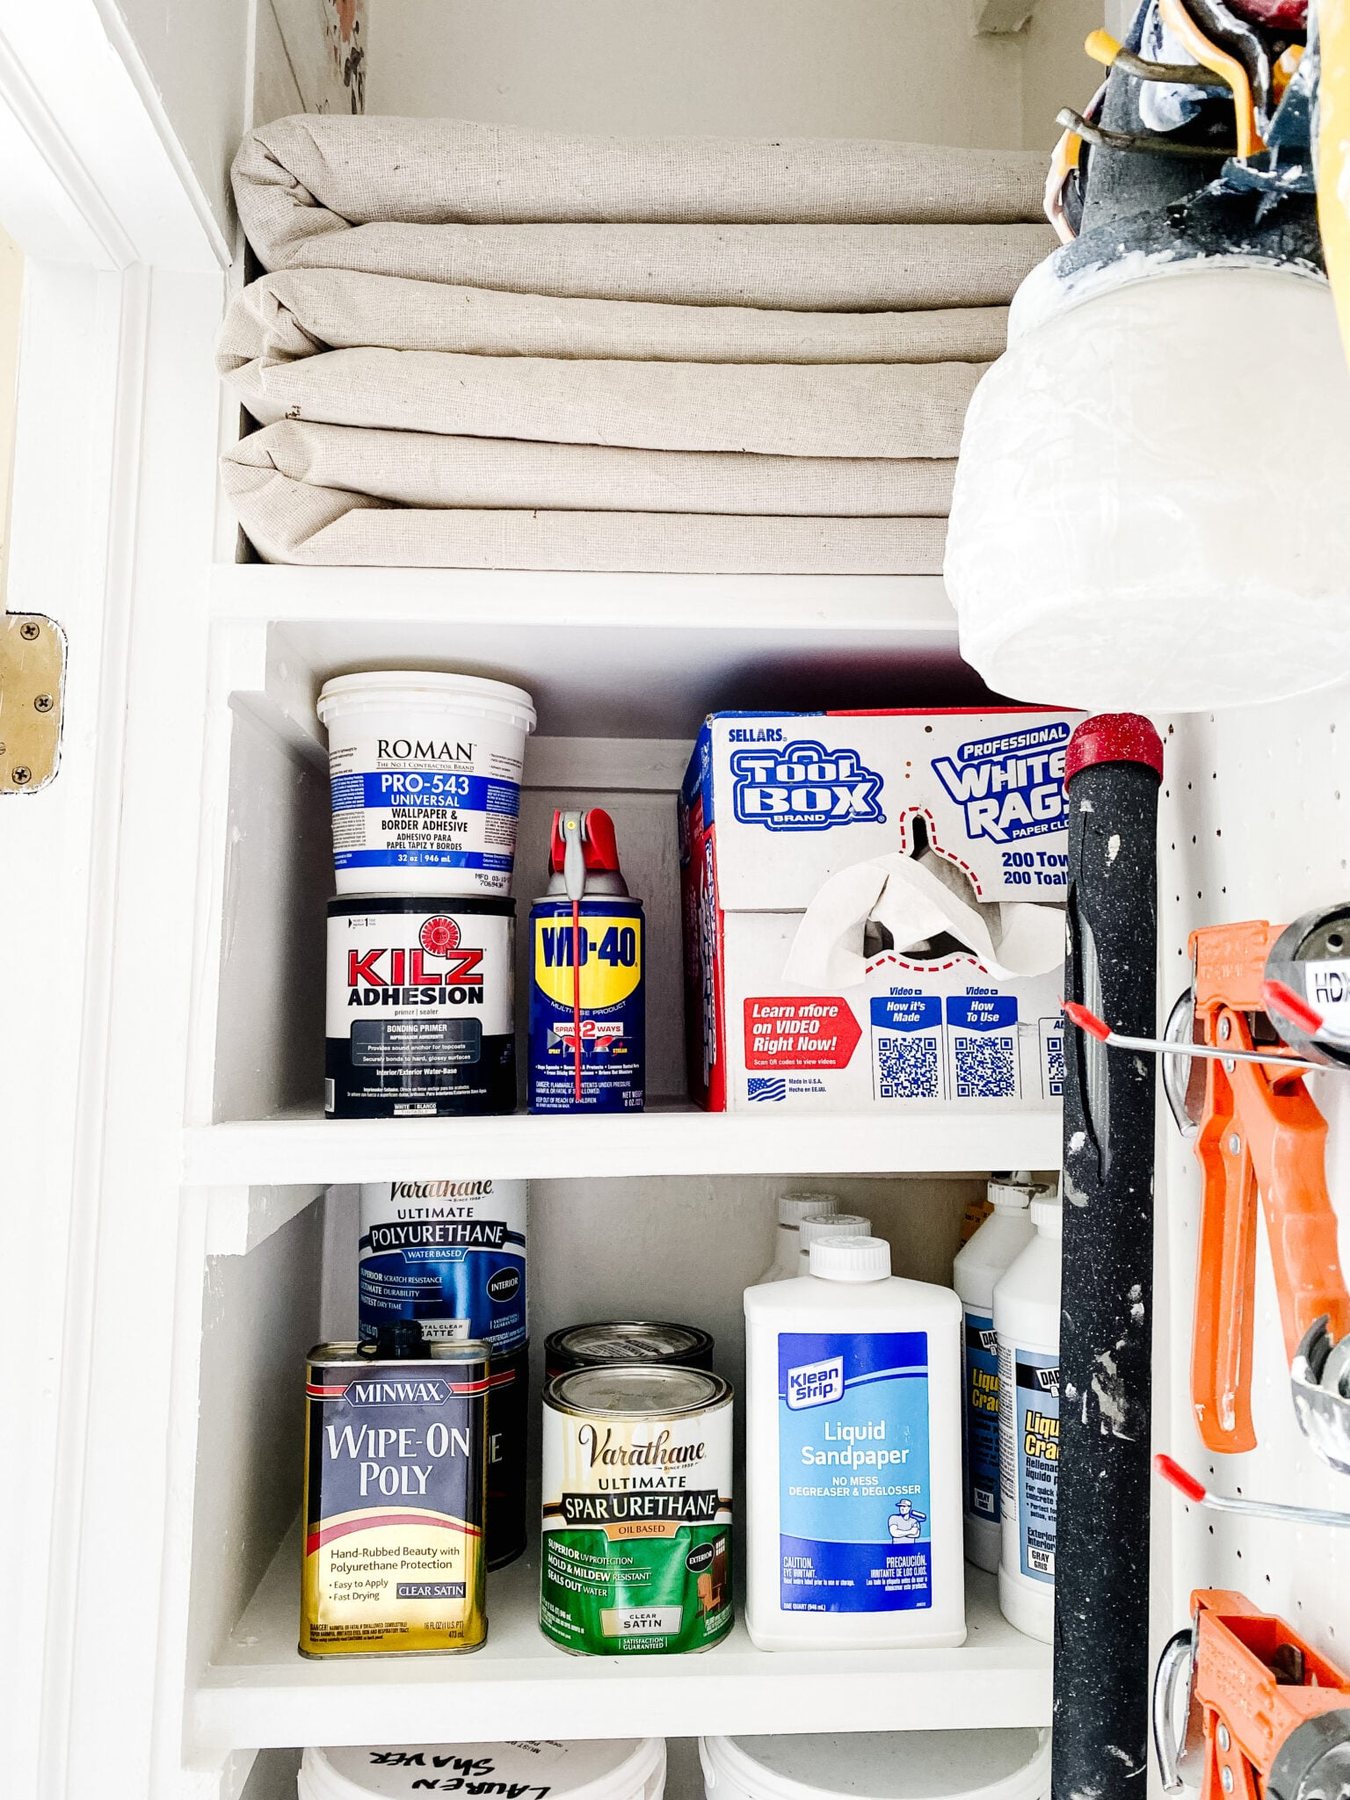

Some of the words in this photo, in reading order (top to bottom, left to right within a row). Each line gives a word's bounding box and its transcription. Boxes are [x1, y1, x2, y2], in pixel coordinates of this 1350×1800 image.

[729, 729, 782, 742] SELLARS
[964, 726, 1066, 759] PROFESSIONAL
[377, 740, 472, 760] ROMAN
[741, 759, 862, 782] TOOL
[935, 749, 1066, 801] WHITE
[381, 775, 469, 795] PRO-543
[391, 795, 459, 807] UNIVERSAL
[744, 783, 872, 815] BOX
[392, 809, 447, 819] WALLPAPER
[451, 811, 457, 819] &
[382, 819, 418, 830] BORDER
[422, 820, 468, 832] ADHESIVE
[1013, 824, 1048, 838] PAPER
[397, 833, 431, 841] ADHESIVO
[1002, 852, 1034, 867] 200
[1004, 871, 1031, 884] 200
[542, 927, 635, 967] WD-40
[348, 948, 483, 986] KILZ
[348, 987, 483, 1006] ADHESION
[966, 987, 989, 995] Video
[551, 1002, 590, 1015] MULTI-SE
[593, 1003, 626, 1015] PRODUCT
[753, 1004, 794, 1018] Learn
[800, 1004, 838, 1017] more
[887, 1002, 907, 1011] How
[910, 1002, 926, 1010] it's
[971, 1002, 994, 1010] How
[893, 1013, 920, 1022] Made
[967, 1013, 978, 1021] To
[981, 1013, 999, 1021] Use
[583, 1022, 595, 1037] 2
[753, 1023, 770, 1034] on
[777, 1021, 820, 1033] VIDEO
[754, 1037, 793, 1054] Right
[798, 1037, 837, 1050] Now!
[391, 1180, 492, 1201] Varathane
[398, 1208, 474, 1219] ULTIMATE
[372, 1225, 504, 1247] POLYURETHANE
[384, 1275, 407, 1283] SCRATCH
[492, 1277, 518, 1292] INTERIOR
[384, 1289, 419, 1297] DURABILITY
[791, 1368, 838, 1387] Klean
[356, 1384, 439, 1403] MINWAX
[796, 1384, 833, 1400] Strip
[825, 1420, 885, 1445] Liquid
[326, 1423, 469, 1460] WIPE-ON
[579, 1424, 705, 1468] Varathane
[801, 1446, 909, 1470] Sandpaper
[360, 1462, 434, 1496] POLY
[599, 1476, 686, 1490] ULTIMATE
[833, 1477, 847, 1485] NO
[850, 1476, 878, 1485] MESS
[789, 1487, 849, 1496] DEGREASER
[853, 1487, 859, 1495] &
[862, 1485, 921, 1495] DEGLOSSER
[566, 1498, 609, 1518] SPAR
[613, 1495, 715, 1517] URETHANE
[331, 1548, 400, 1559] Hand-Rubbed
[403, 1548, 437, 1557] Beauty
[548, 1538, 579, 1560] SUPERIOR
[581, 1553, 588, 1561] UV
[589, 1556, 633, 1565] PROTECTION
[689, 1551, 712, 1565] EXTERIOR
[1032, 1550, 1049, 1562] GRAY
[331, 1561, 398, 1575] Polyurethane
[401, 1560, 452, 1569] Protection
[548, 1554, 565, 1571] MOLD
[567, 1565, 572, 1573] &
[573, 1567, 610, 1582] MILDEW
[784, 1557, 813, 1568] CAUTION.
[886, 1553, 927, 1568] PRECAUCIÓN.
[334, 1581, 352, 1590] Easy
[365, 1579, 388, 1589] Apply
[399, 1587, 431, 1595] CLEAR
[434, 1586, 463, 1595] SATIN
[548, 1570, 564, 1586] SEALS
[565, 1580, 582, 1593] OUT
[583, 1586, 607, 1597] WATER
[353, 1592, 379, 1601] Drying
[624, 1620, 662, 1628] SATIN
[369, 1752, 495, 1776] SHAVER
[412, 1778, 551, 1800] LAUREN
